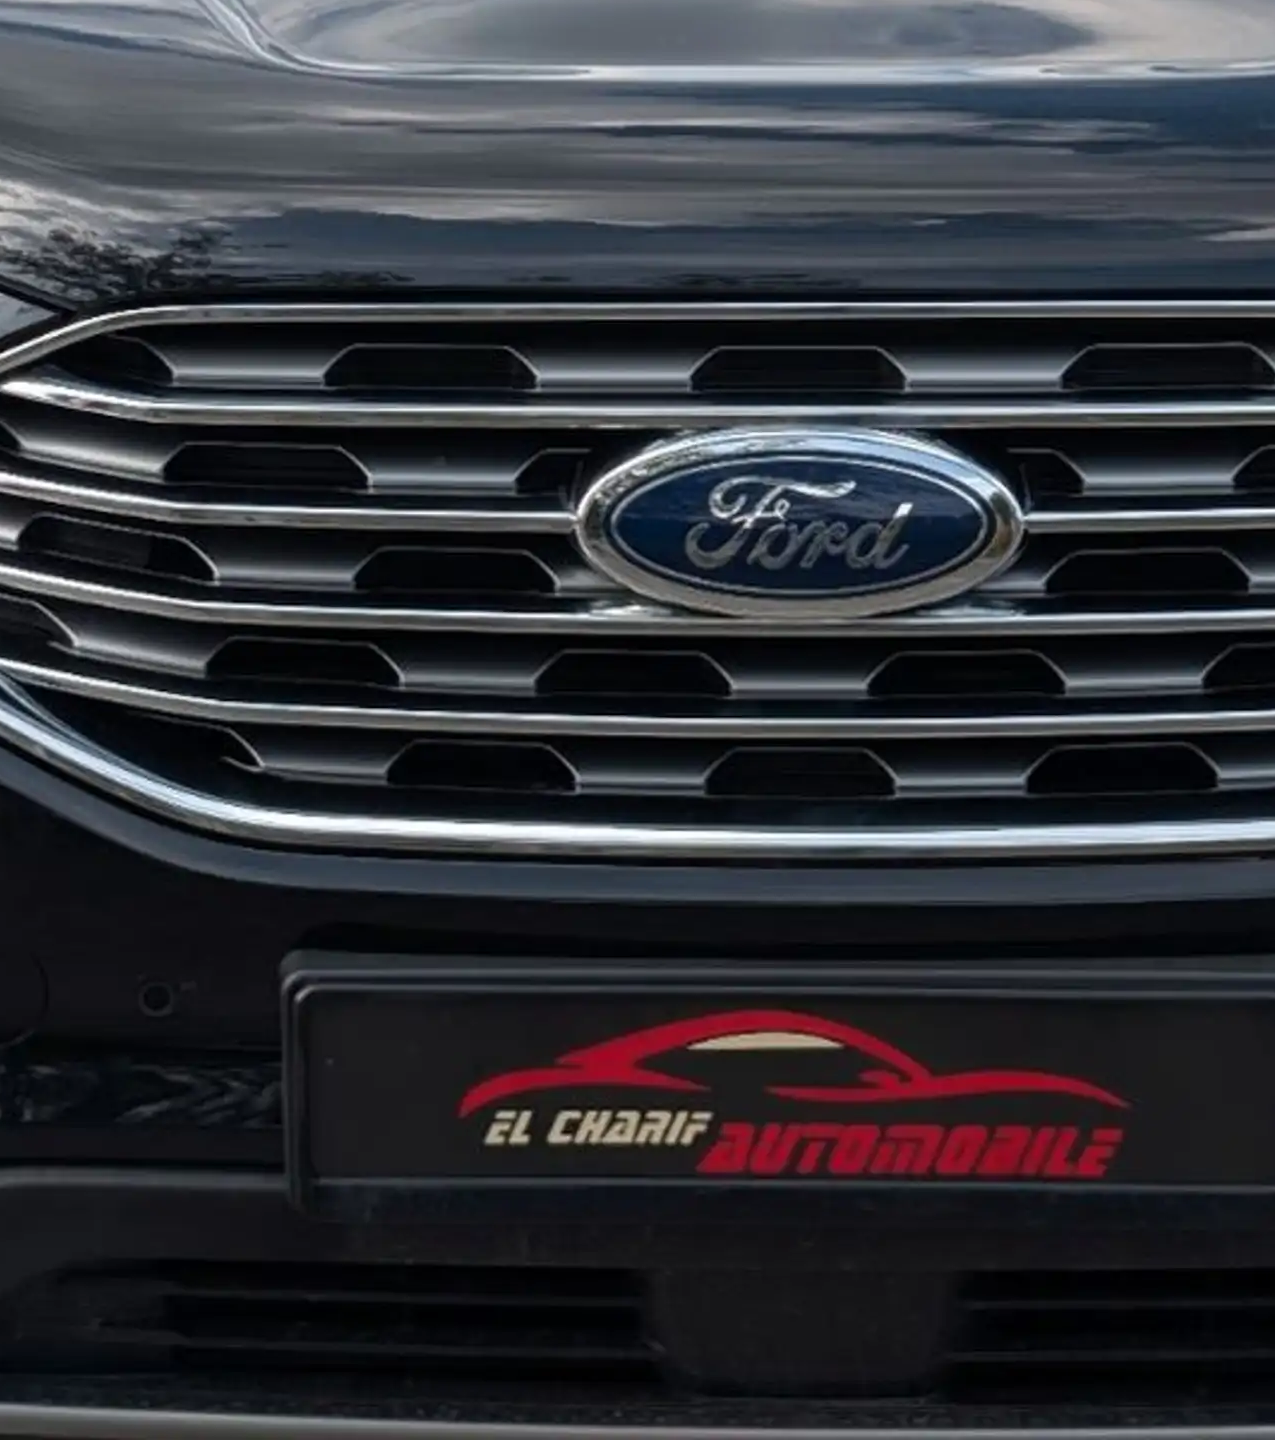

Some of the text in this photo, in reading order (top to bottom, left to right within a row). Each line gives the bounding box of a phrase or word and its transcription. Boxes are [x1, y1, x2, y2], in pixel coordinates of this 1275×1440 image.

[684, 475, 913, 570] Ford
[485, 1111, 714, 1147] EL CHARIF
[697, 1122, 1124, 1178] AUTOMOBILE
